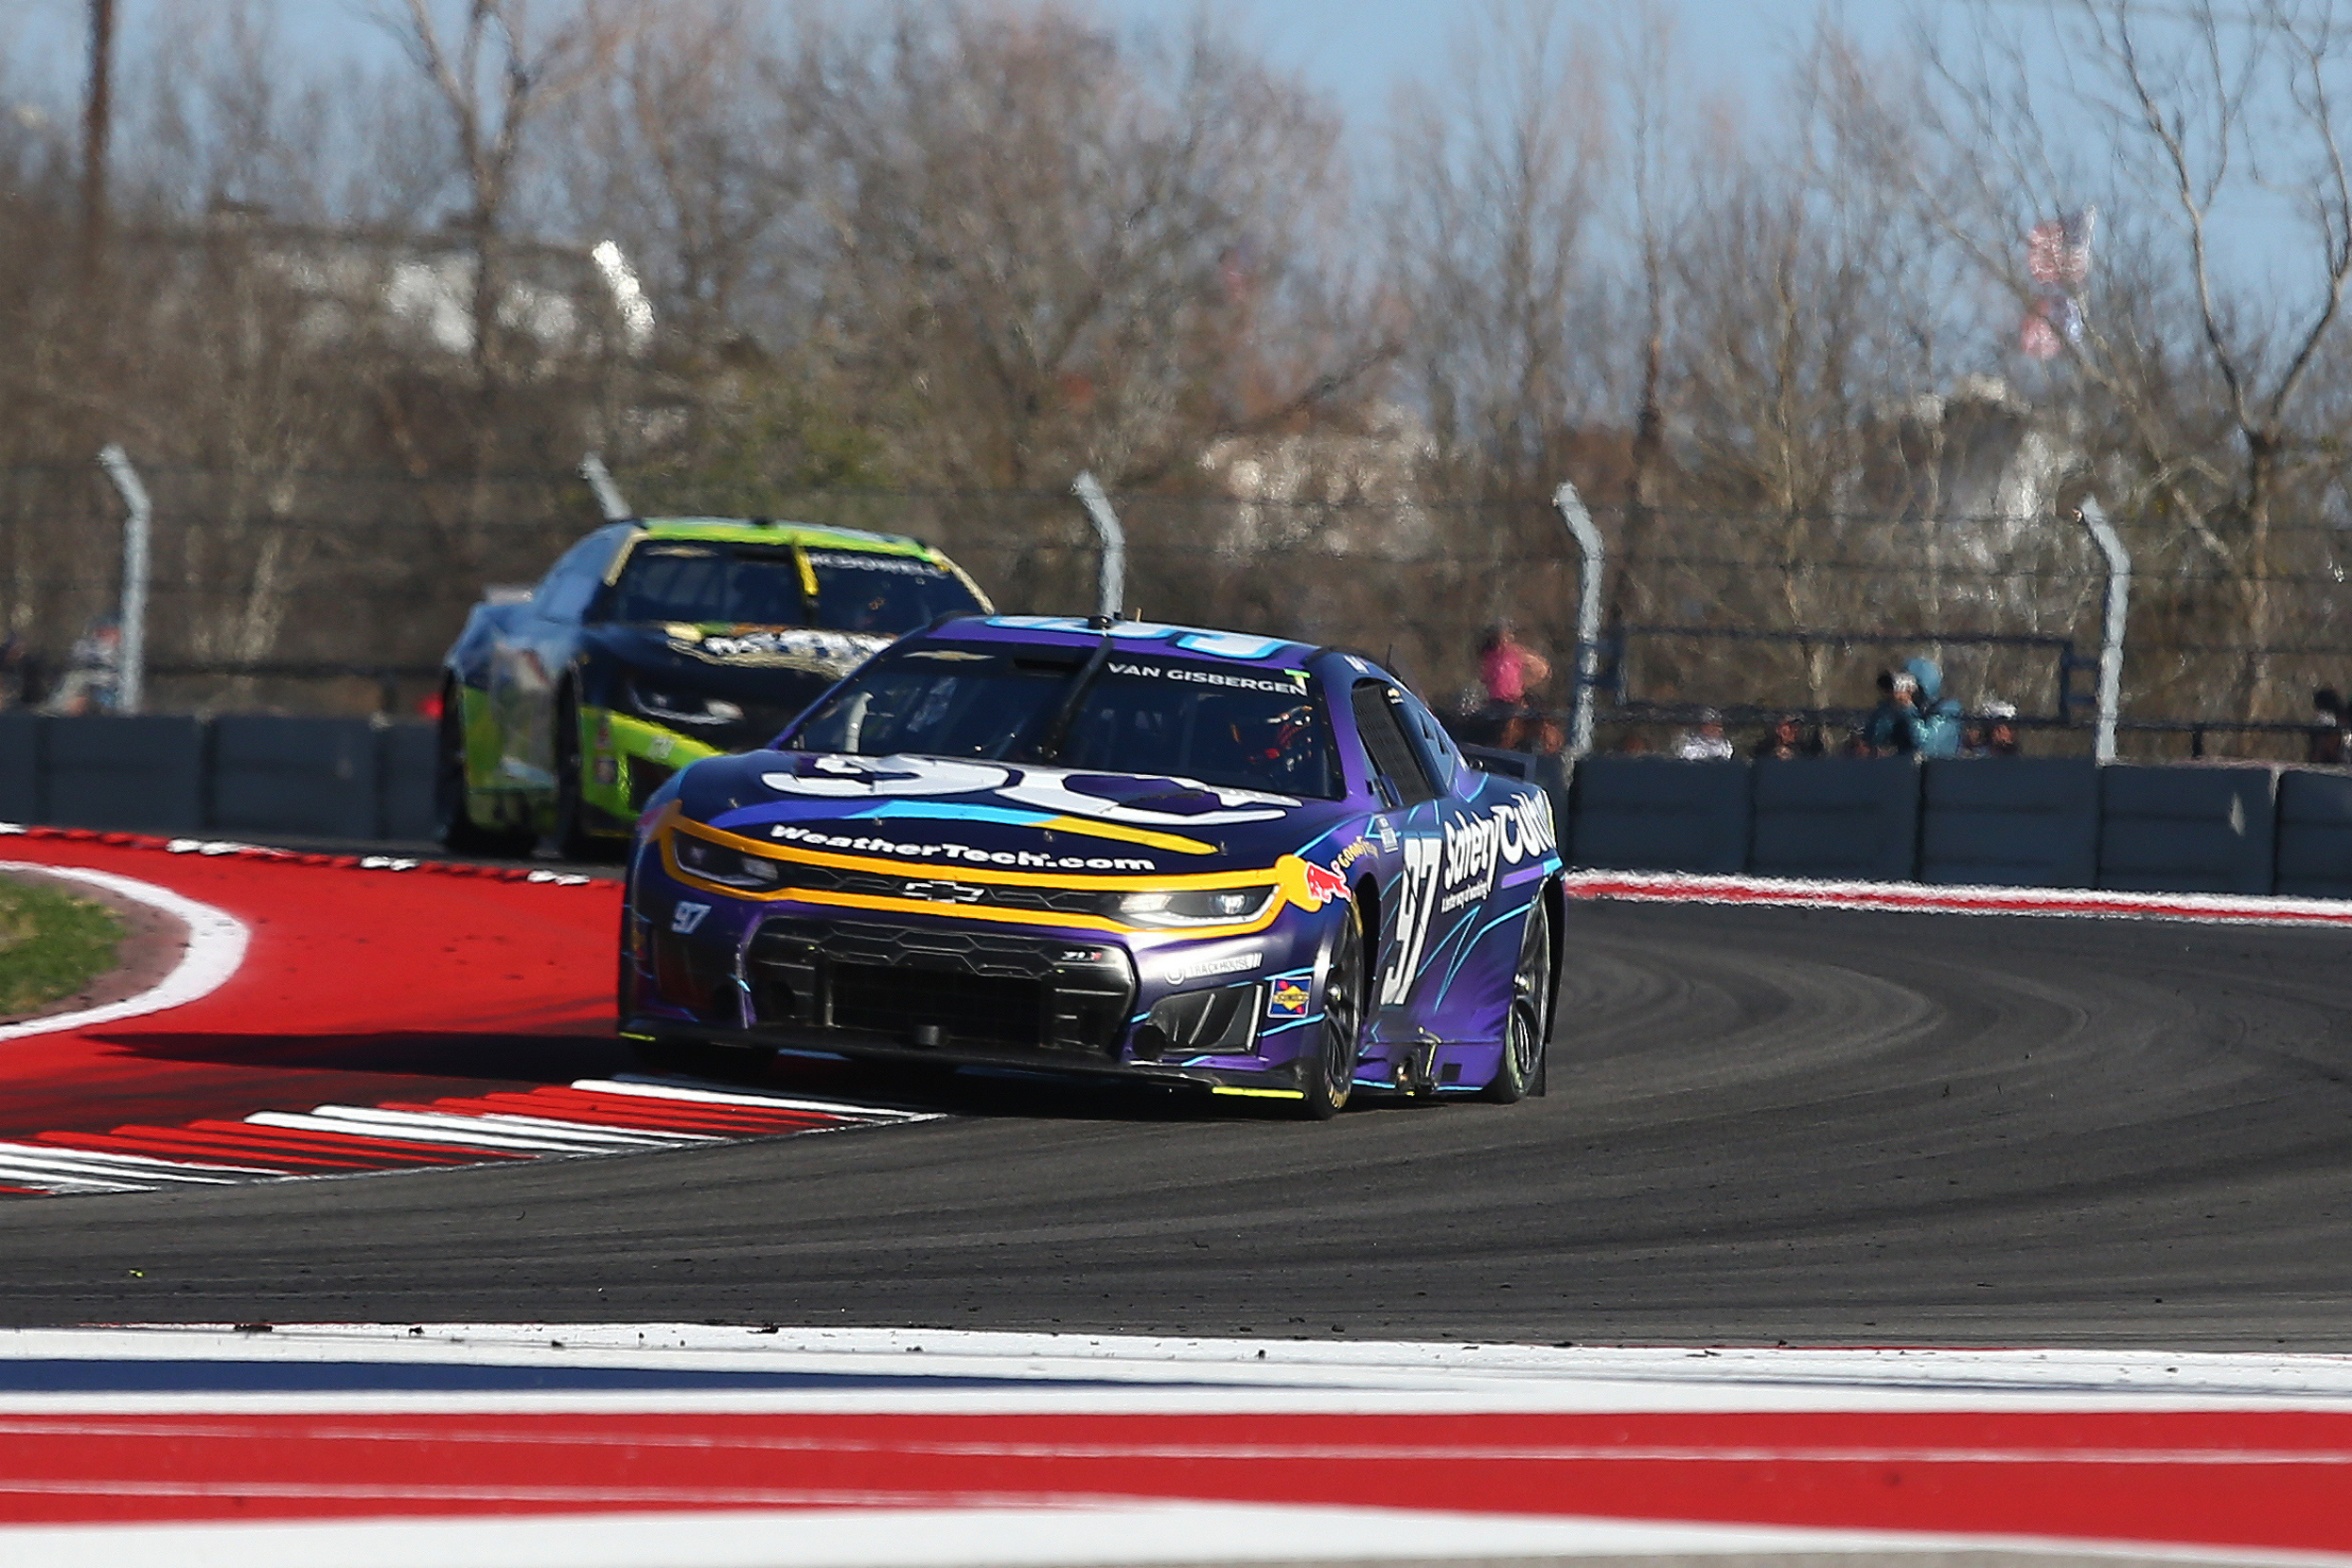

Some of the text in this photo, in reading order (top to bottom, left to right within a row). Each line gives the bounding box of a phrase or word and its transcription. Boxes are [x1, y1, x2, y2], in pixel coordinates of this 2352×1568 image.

[1107, 661, 1309, 697] VAN GISBERGEN
[770, 824, 1155, 872] WeatherTech.com
[671, 900, 712, 935] 97
[1380, 837, 1443, 1006] 97
